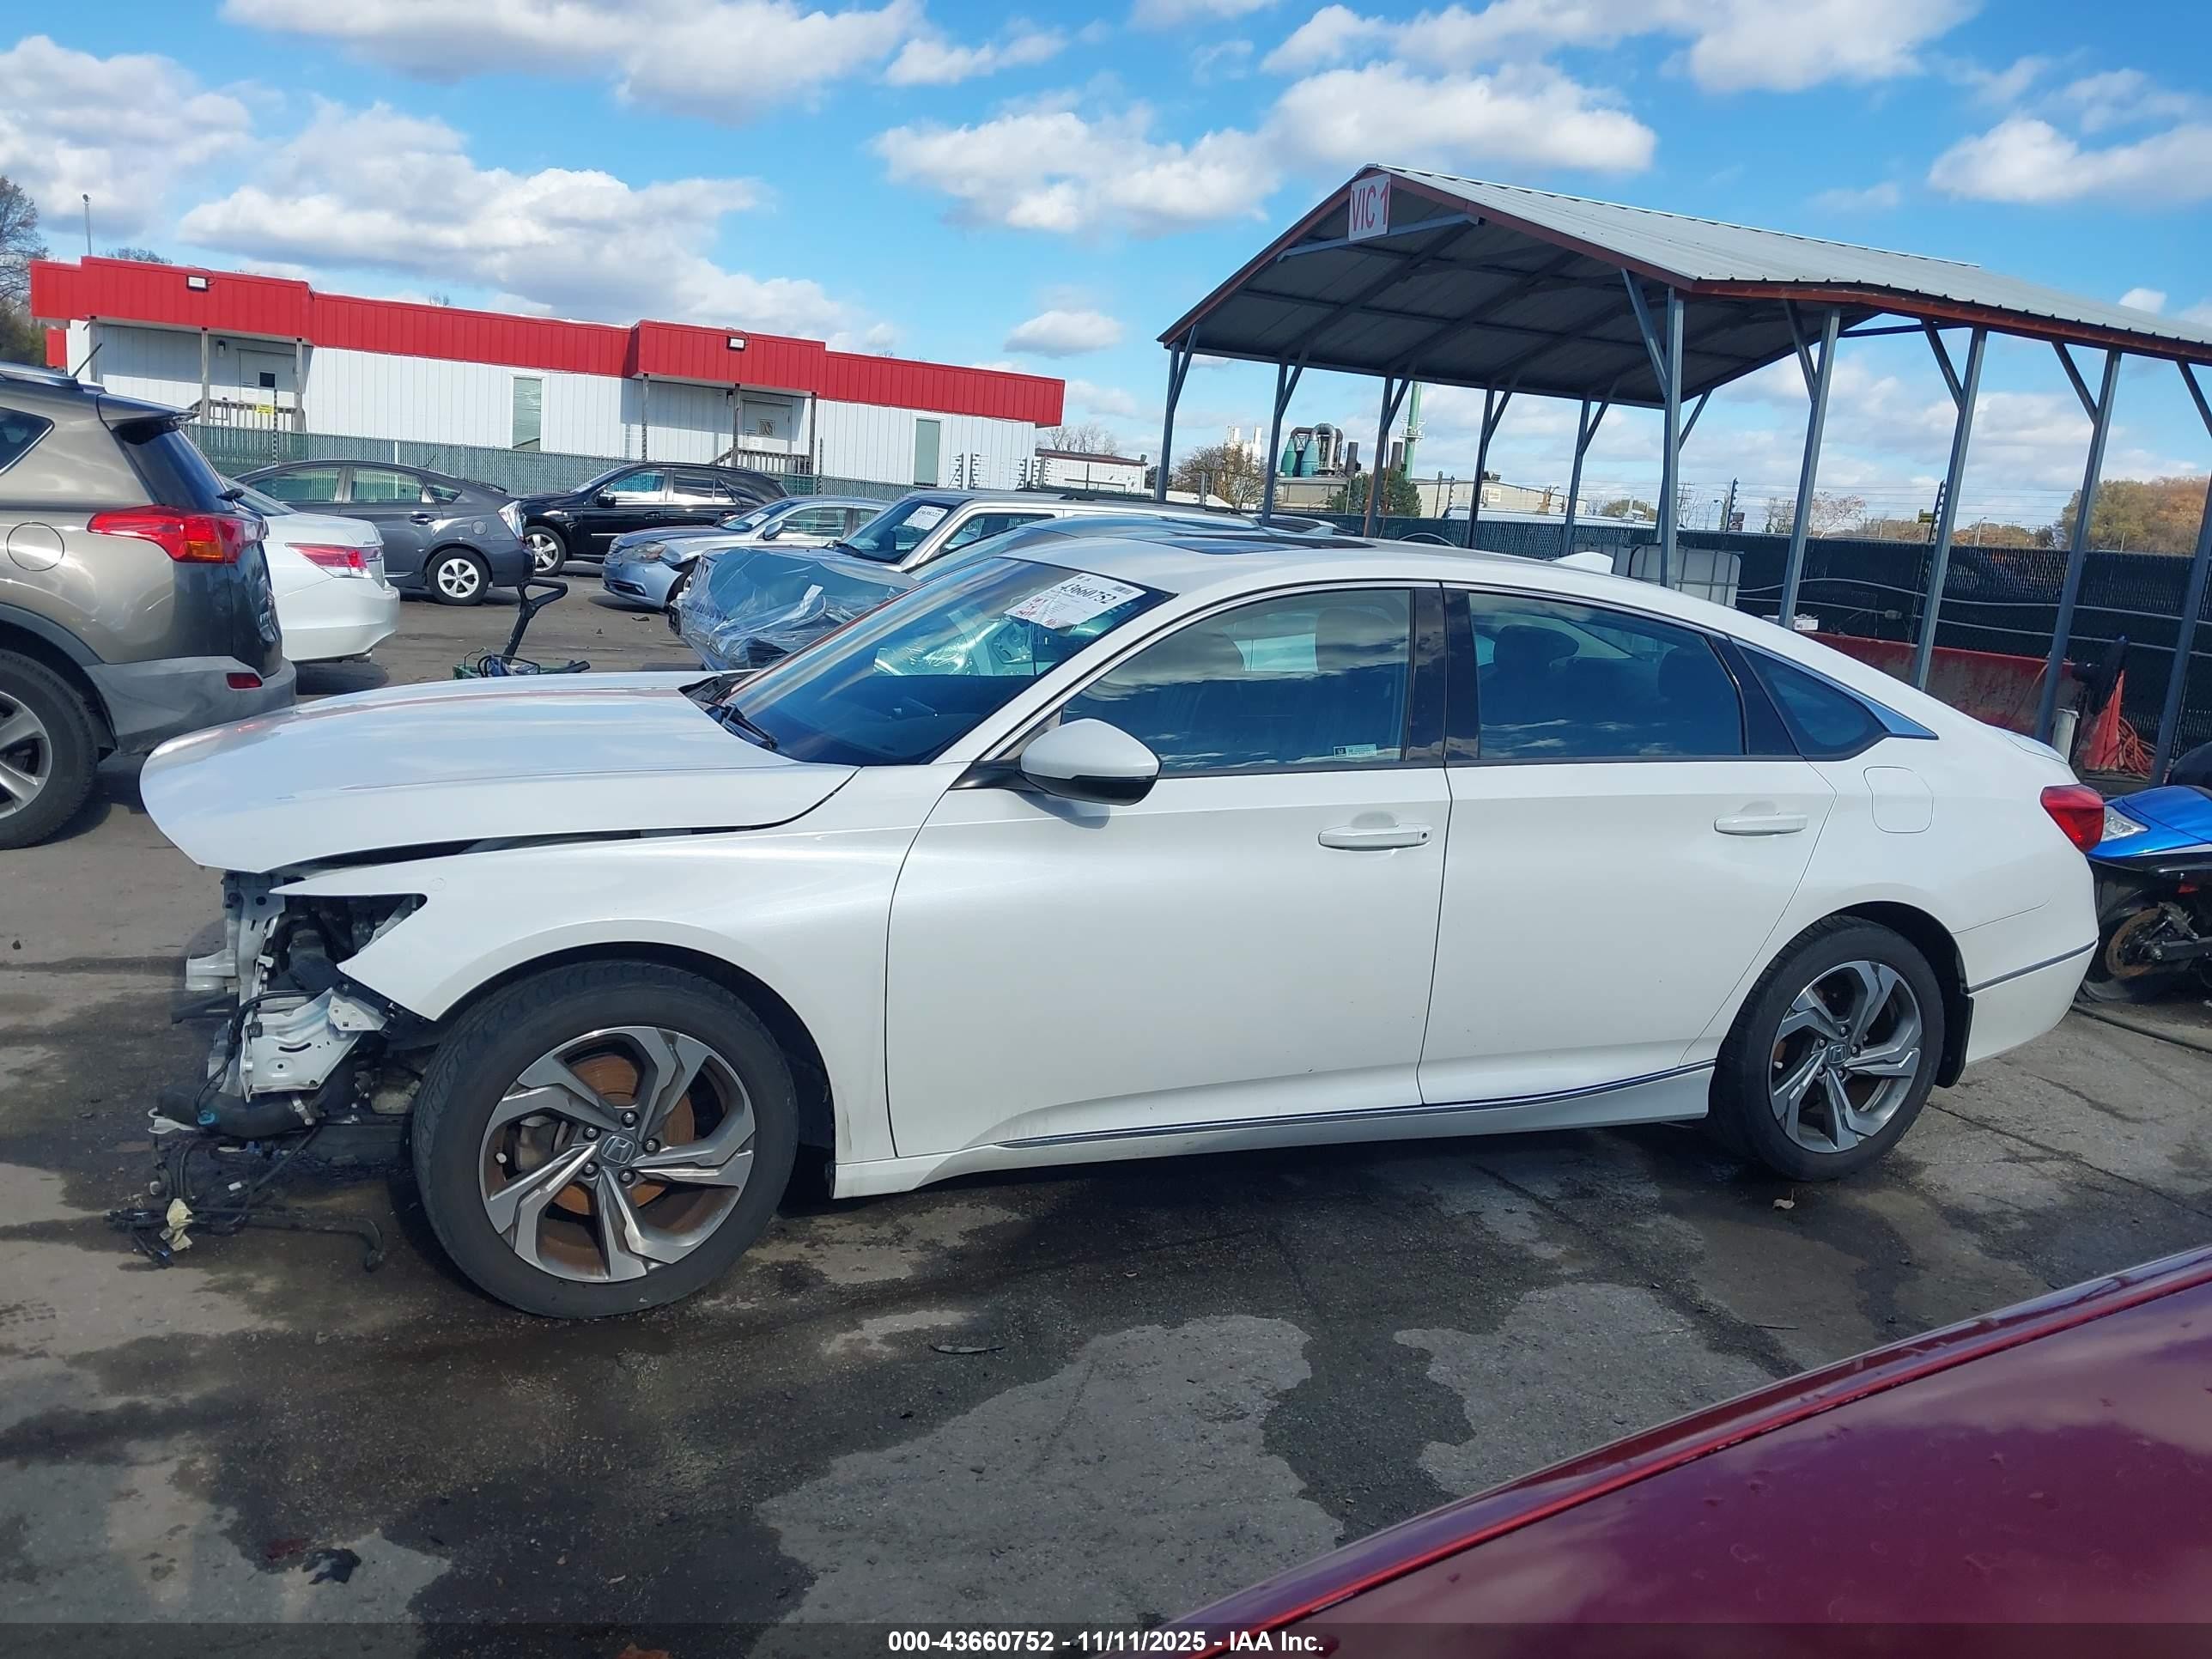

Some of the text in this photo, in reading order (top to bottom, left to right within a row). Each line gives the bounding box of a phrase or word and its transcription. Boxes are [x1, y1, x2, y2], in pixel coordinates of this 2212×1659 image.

[1352, 180, 1389, 232] VIC 1
[1060, 583, 1117, 605] 43660752
